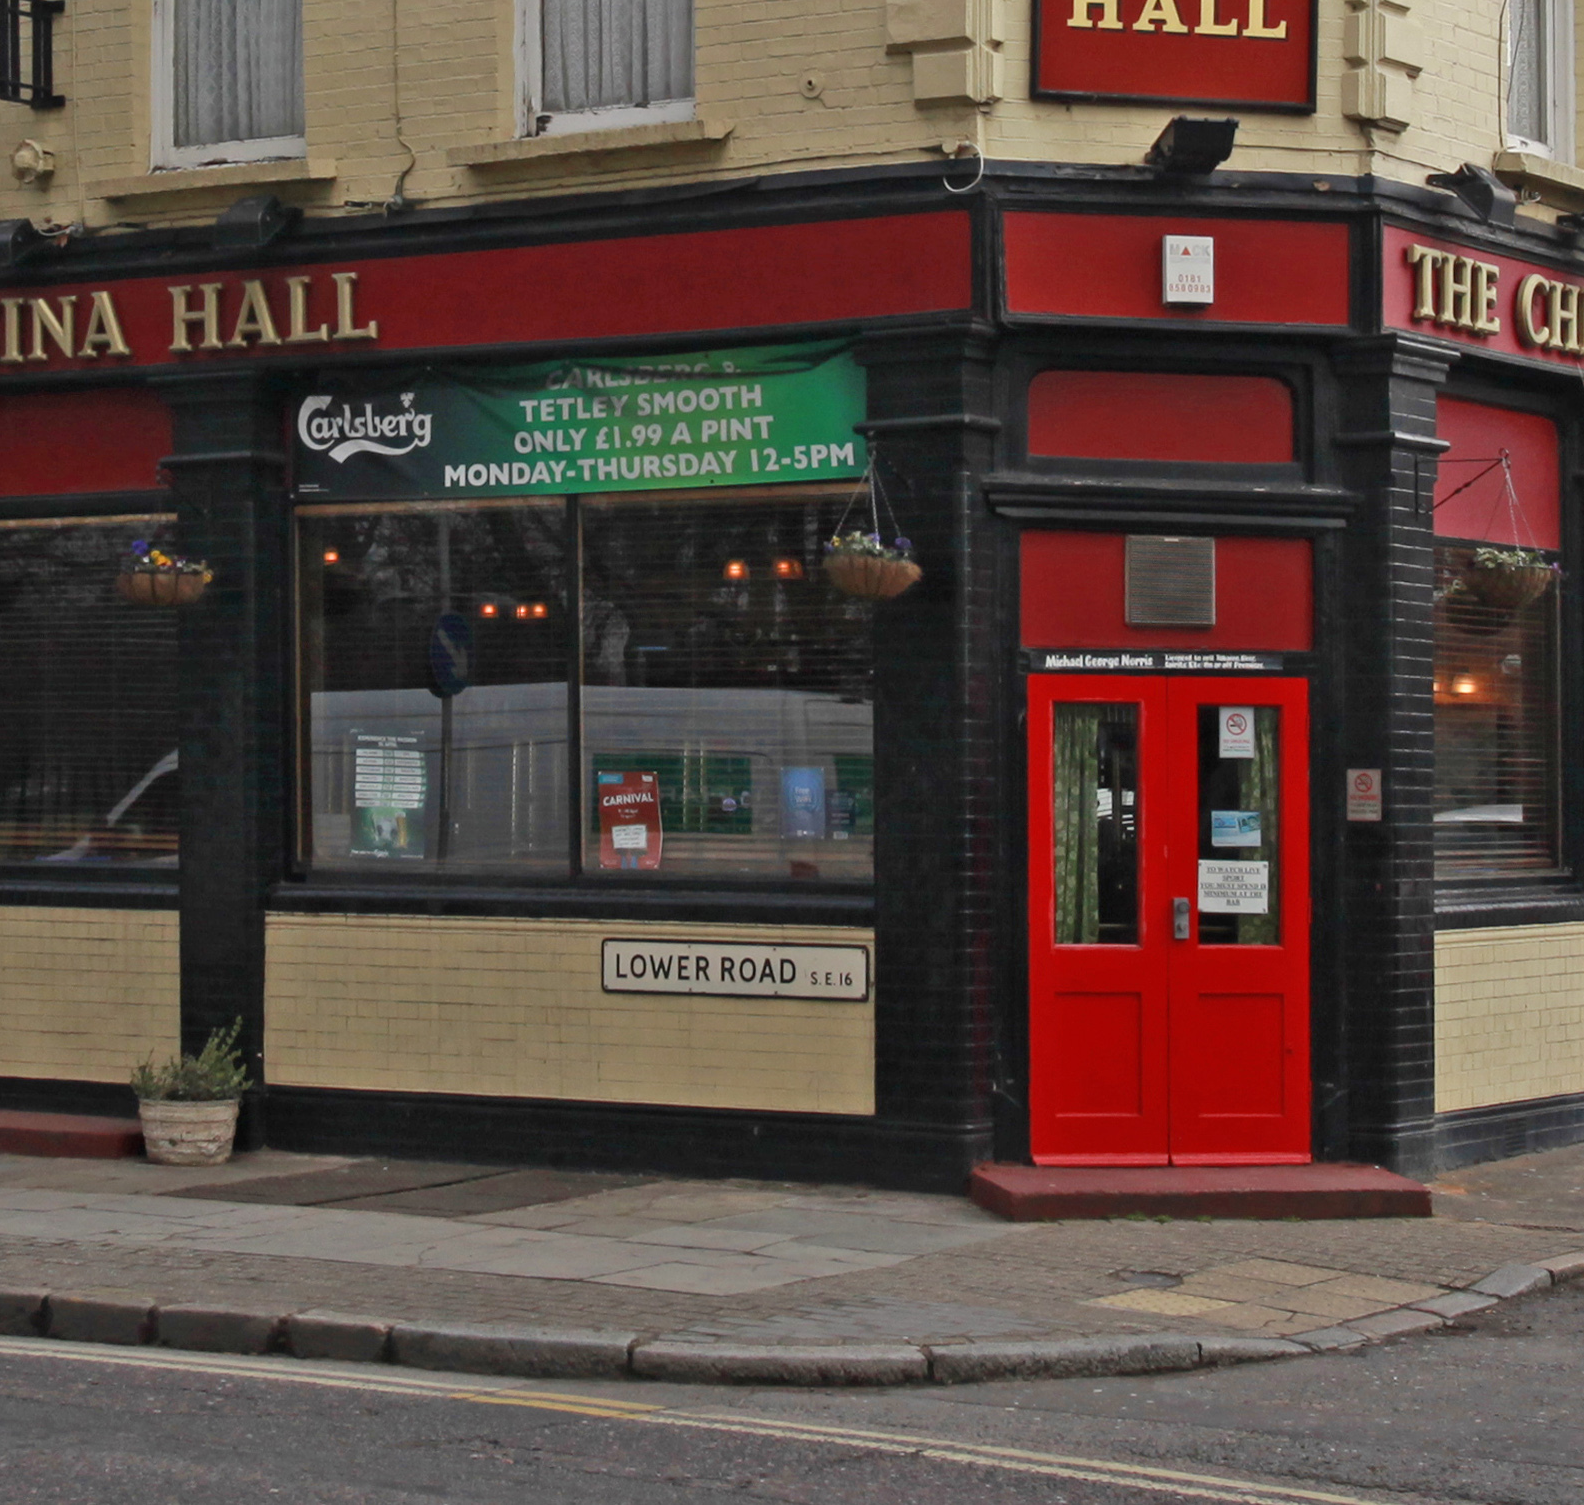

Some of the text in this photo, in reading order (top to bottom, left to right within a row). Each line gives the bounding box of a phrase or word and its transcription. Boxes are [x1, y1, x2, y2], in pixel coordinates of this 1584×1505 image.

[1407, 243, 1501, 336] THE
[168, 272, 378, 354] HALL
[519, 384, 762, 423] TETLEY SMOOTH
[298, 393, 432, 455] Carlsberg
[514, 415, 774, 454] ONLY £1.99 A PINT
[444, 441, 855, 488] MONDAY-THURSDAY 12-5PM
[1045, 654, 1153, 668] Michael George Norris
[603, 792, 654, 807] CARNIVAL
[615, 953, 711, 982] LOWER
[719, 956, 797, 984] ROAD
